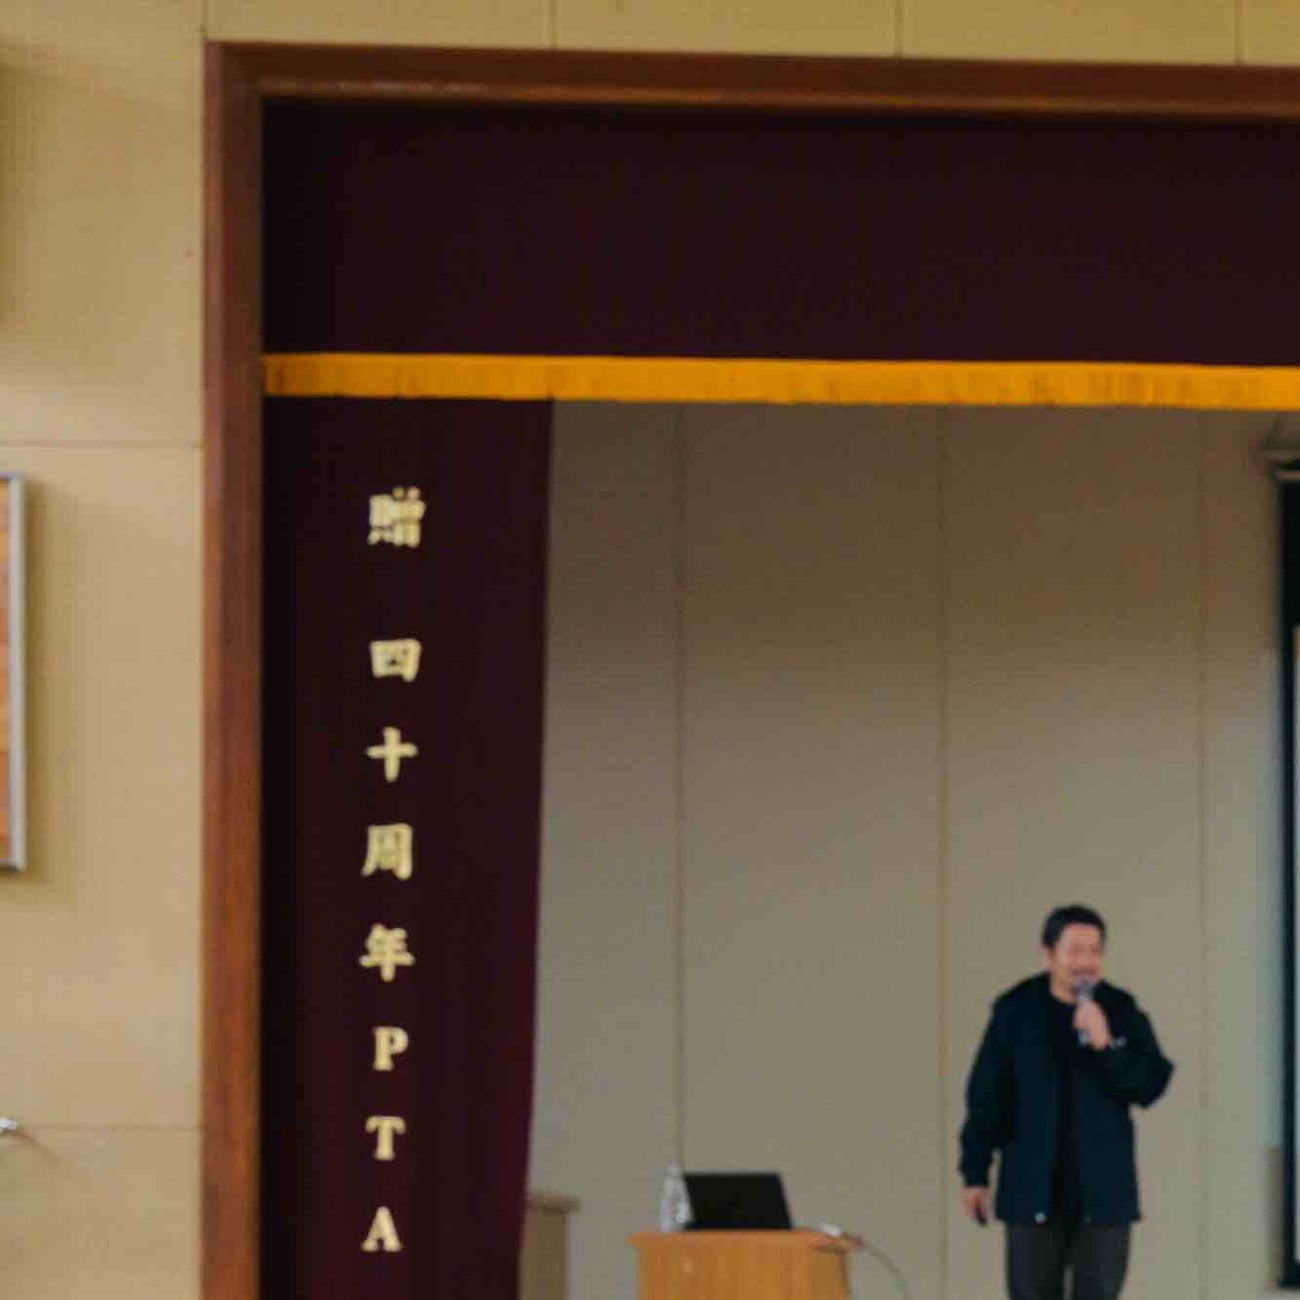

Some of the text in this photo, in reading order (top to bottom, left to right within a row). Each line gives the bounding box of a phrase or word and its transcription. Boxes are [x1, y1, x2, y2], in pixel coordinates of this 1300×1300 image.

[360, 488, 425, 1252] 贈 四十周年PTA
